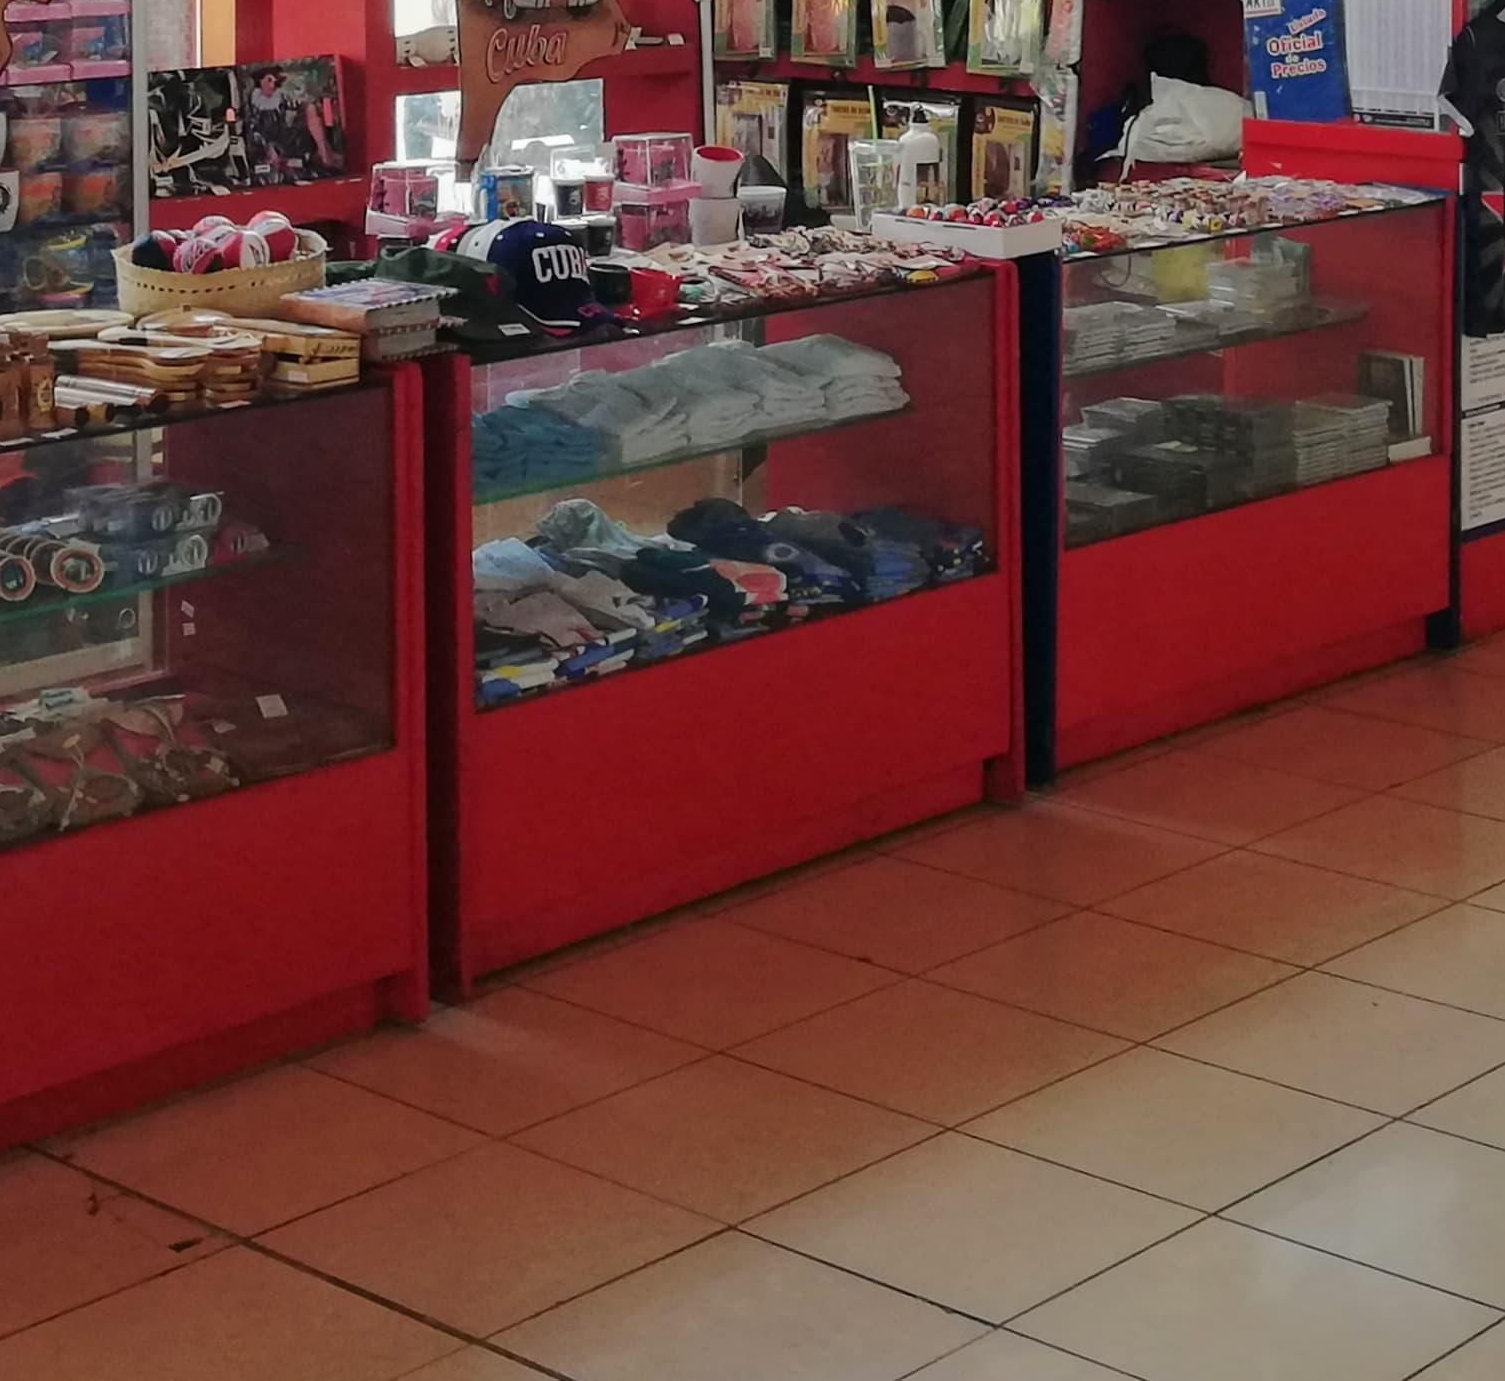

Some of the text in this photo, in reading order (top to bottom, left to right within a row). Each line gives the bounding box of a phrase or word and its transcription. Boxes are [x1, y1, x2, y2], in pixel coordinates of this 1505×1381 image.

[485, 23, 568, 84] Cuba
[1268, 32, 1322, 55] Oficial
[1271, 59, 1326, 79] Precios
